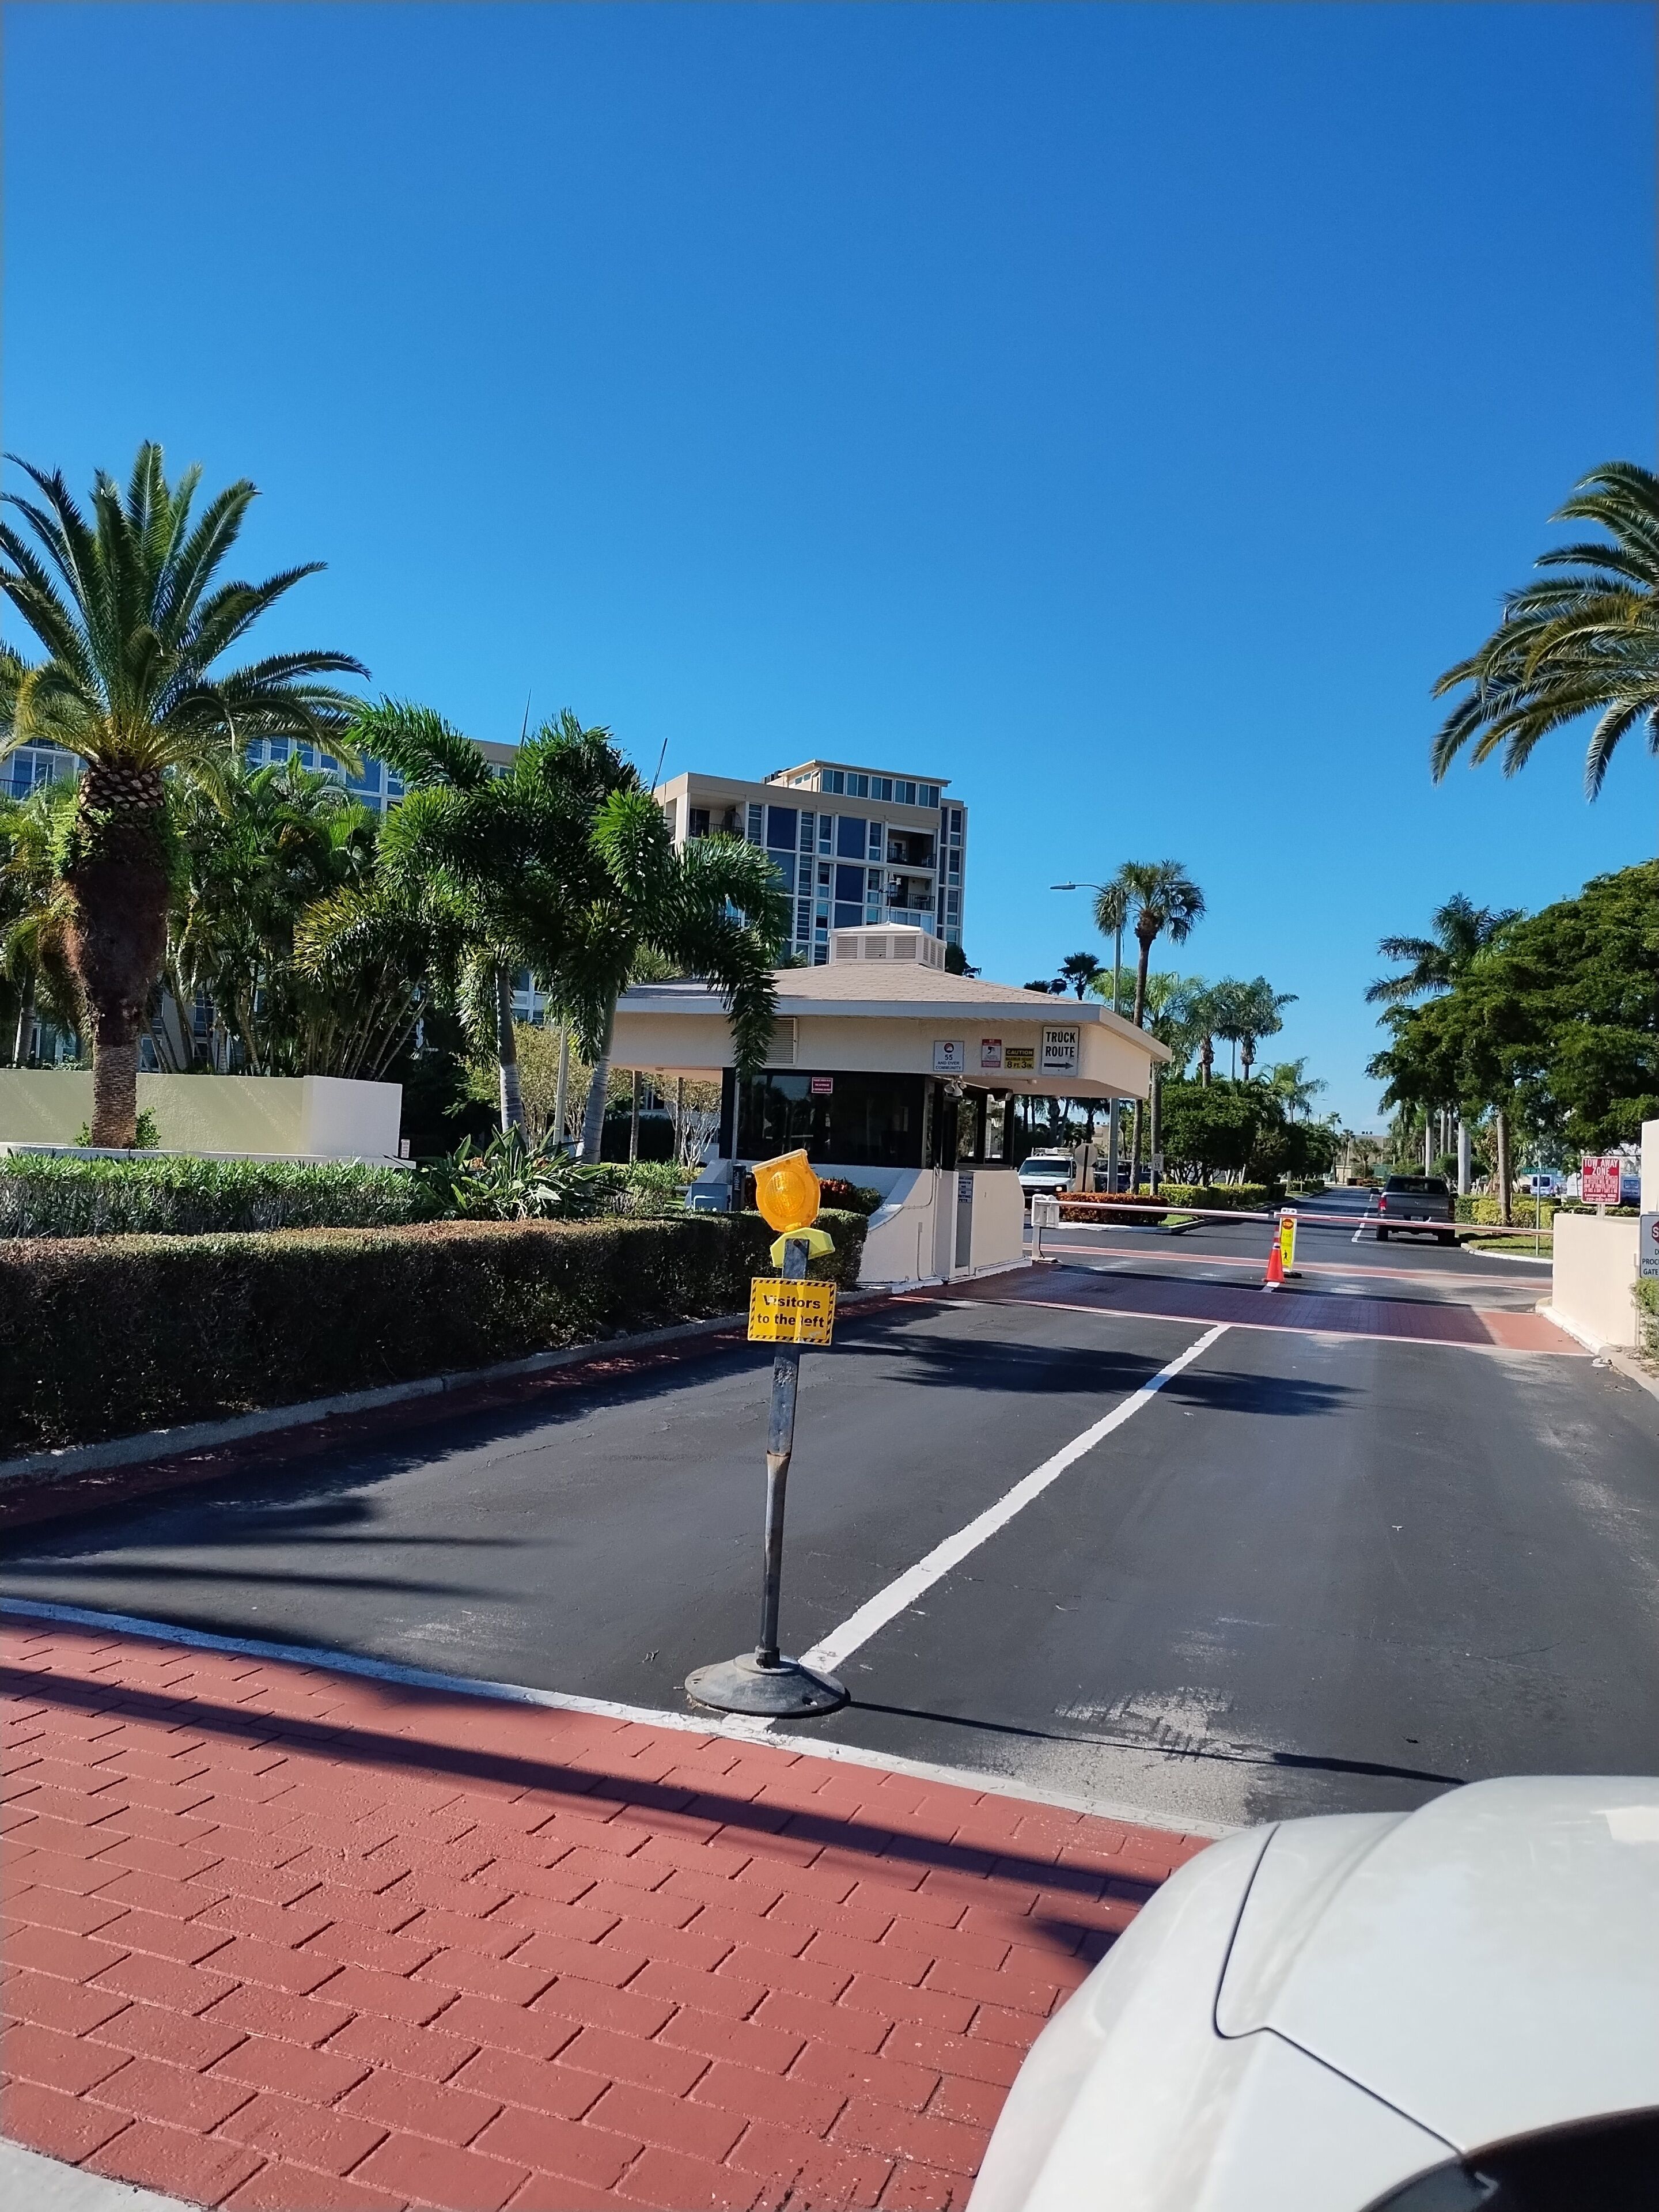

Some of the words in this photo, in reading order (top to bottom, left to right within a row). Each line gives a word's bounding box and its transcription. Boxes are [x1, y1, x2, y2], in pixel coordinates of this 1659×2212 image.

[1046, 1031, 1075, 1043] TRUCK
[1046, 1046, 1075, 1057] ROUTE
[1584, 1158, 1598, 1167] TOW
[1601, 1159, 1618, 1168] AWAY
[1592, 1167, 1610, 1176] ZONE
[757, 1313, 770, 1324] to
[775, 1313, 796, 1325] the
[801, 1315, 824, 1328] left
